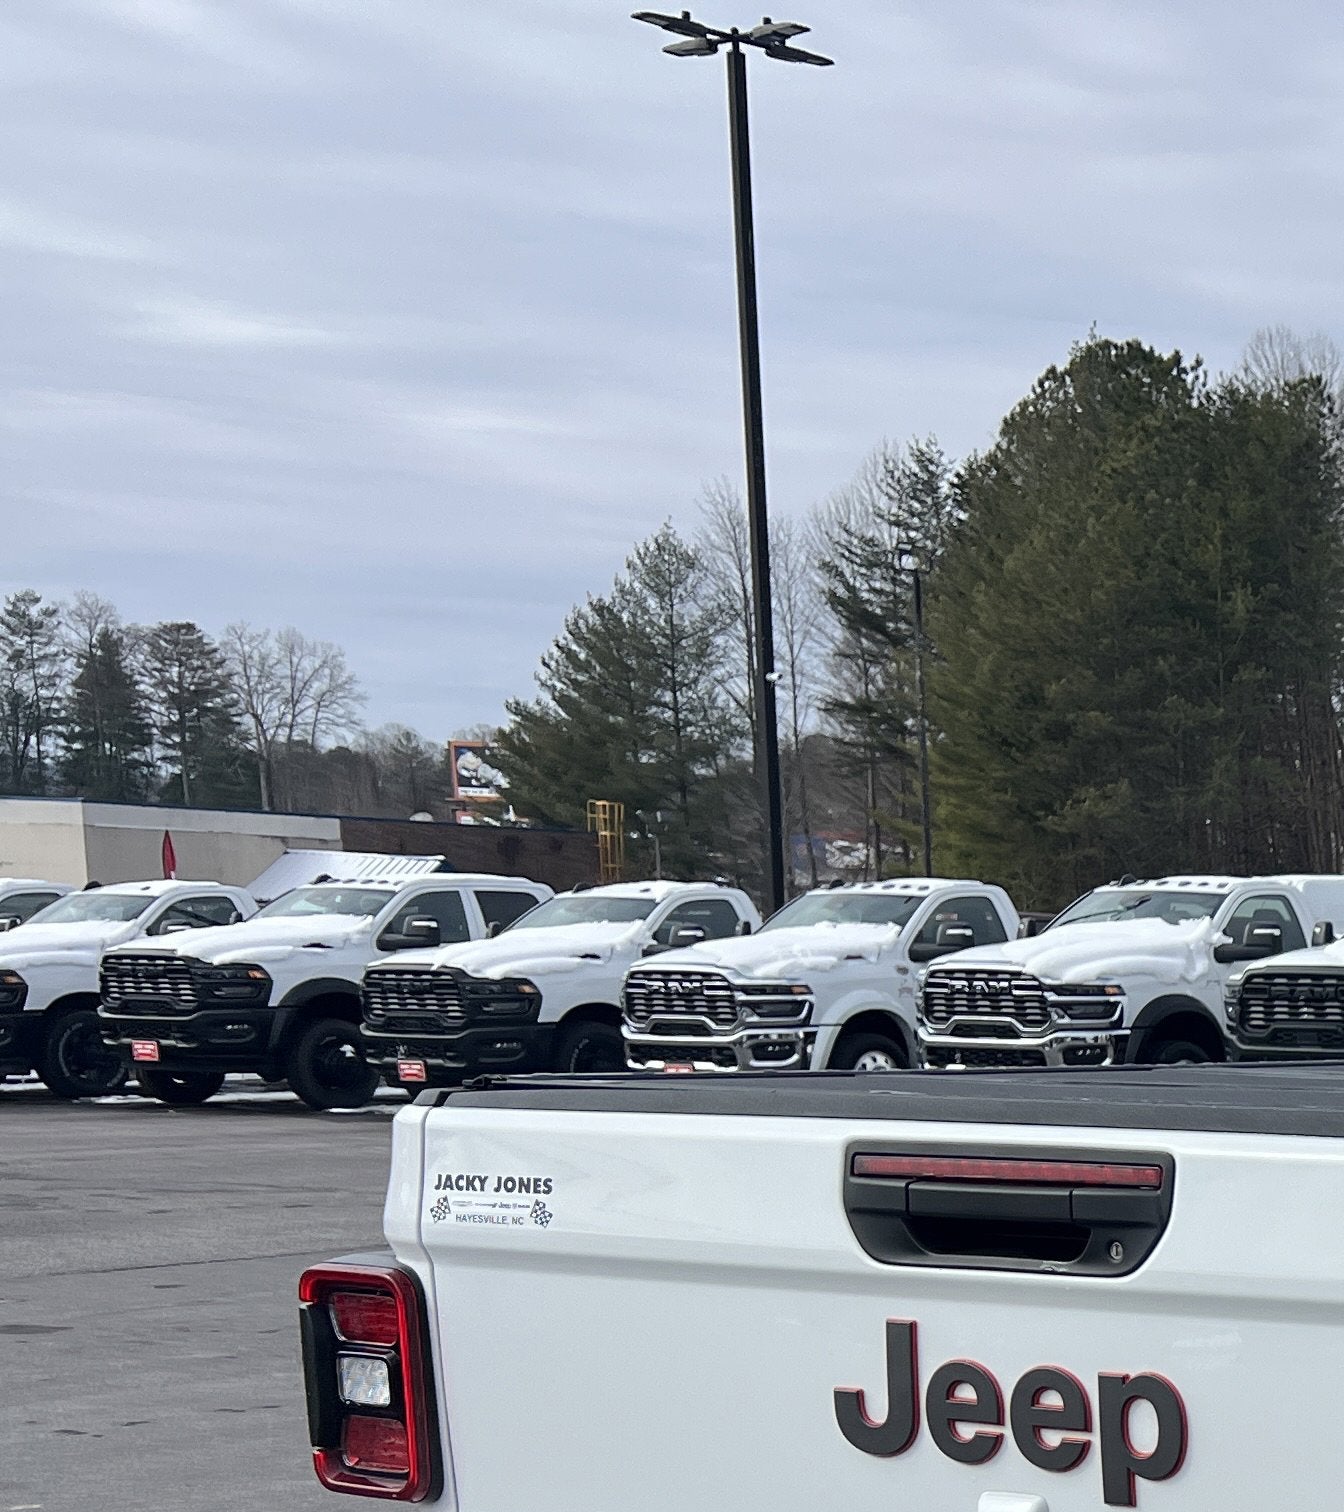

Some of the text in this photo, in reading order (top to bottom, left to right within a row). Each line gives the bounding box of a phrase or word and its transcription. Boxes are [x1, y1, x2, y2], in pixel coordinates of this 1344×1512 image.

[434, 1174, 553, 1195] JACKY JONES
[511, 1216, 524, 1226] NC
[833, 1317, 1189, 1508] Jeep
